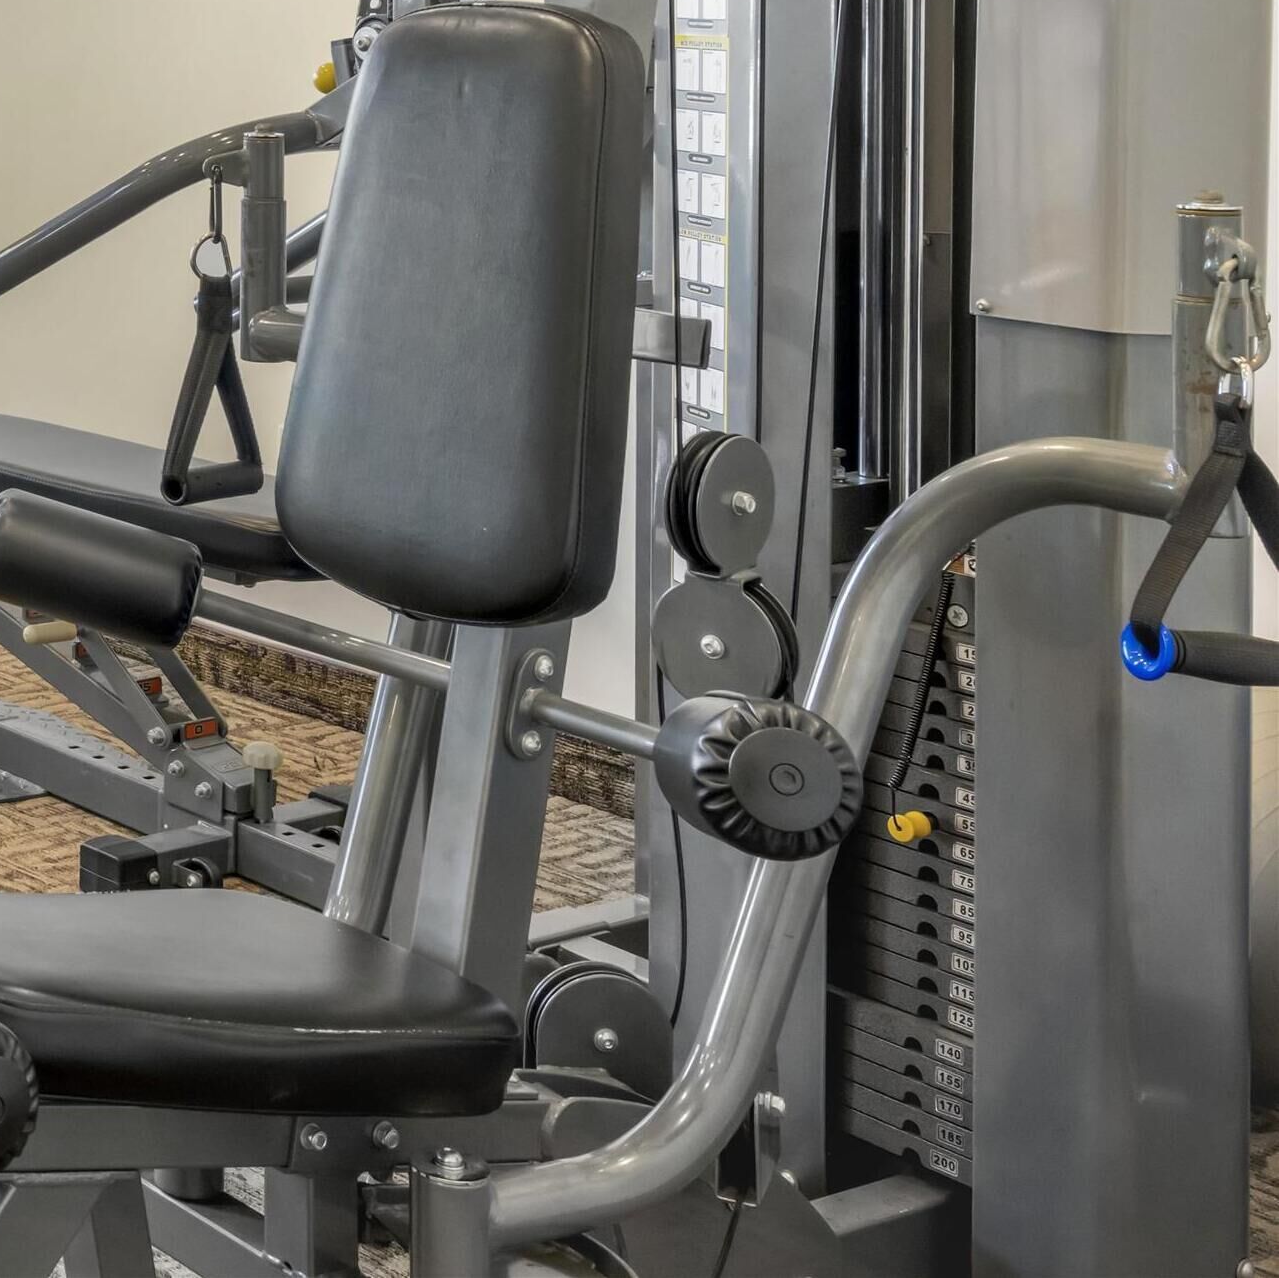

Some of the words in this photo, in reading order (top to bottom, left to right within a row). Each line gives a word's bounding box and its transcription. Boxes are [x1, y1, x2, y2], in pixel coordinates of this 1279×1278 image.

[961, 819, 976, 832] 55
[959, 847, 975, 860] 65
[959, 875, 974, 889] 75
[959, 905, 975, 918] 85
[958, 930, 973, 944] 95
[953, 985, 975, 1002] 115
[951, 1011, 974, 1028] 125
[939, 1043, 961, 1061] 140
[938, 1071, 962, 1089] 155
[938, 1099, 961, 1115] 170
[940, 1128, 963, 1146] 185
[932, 1154, 956, 1172] 200
